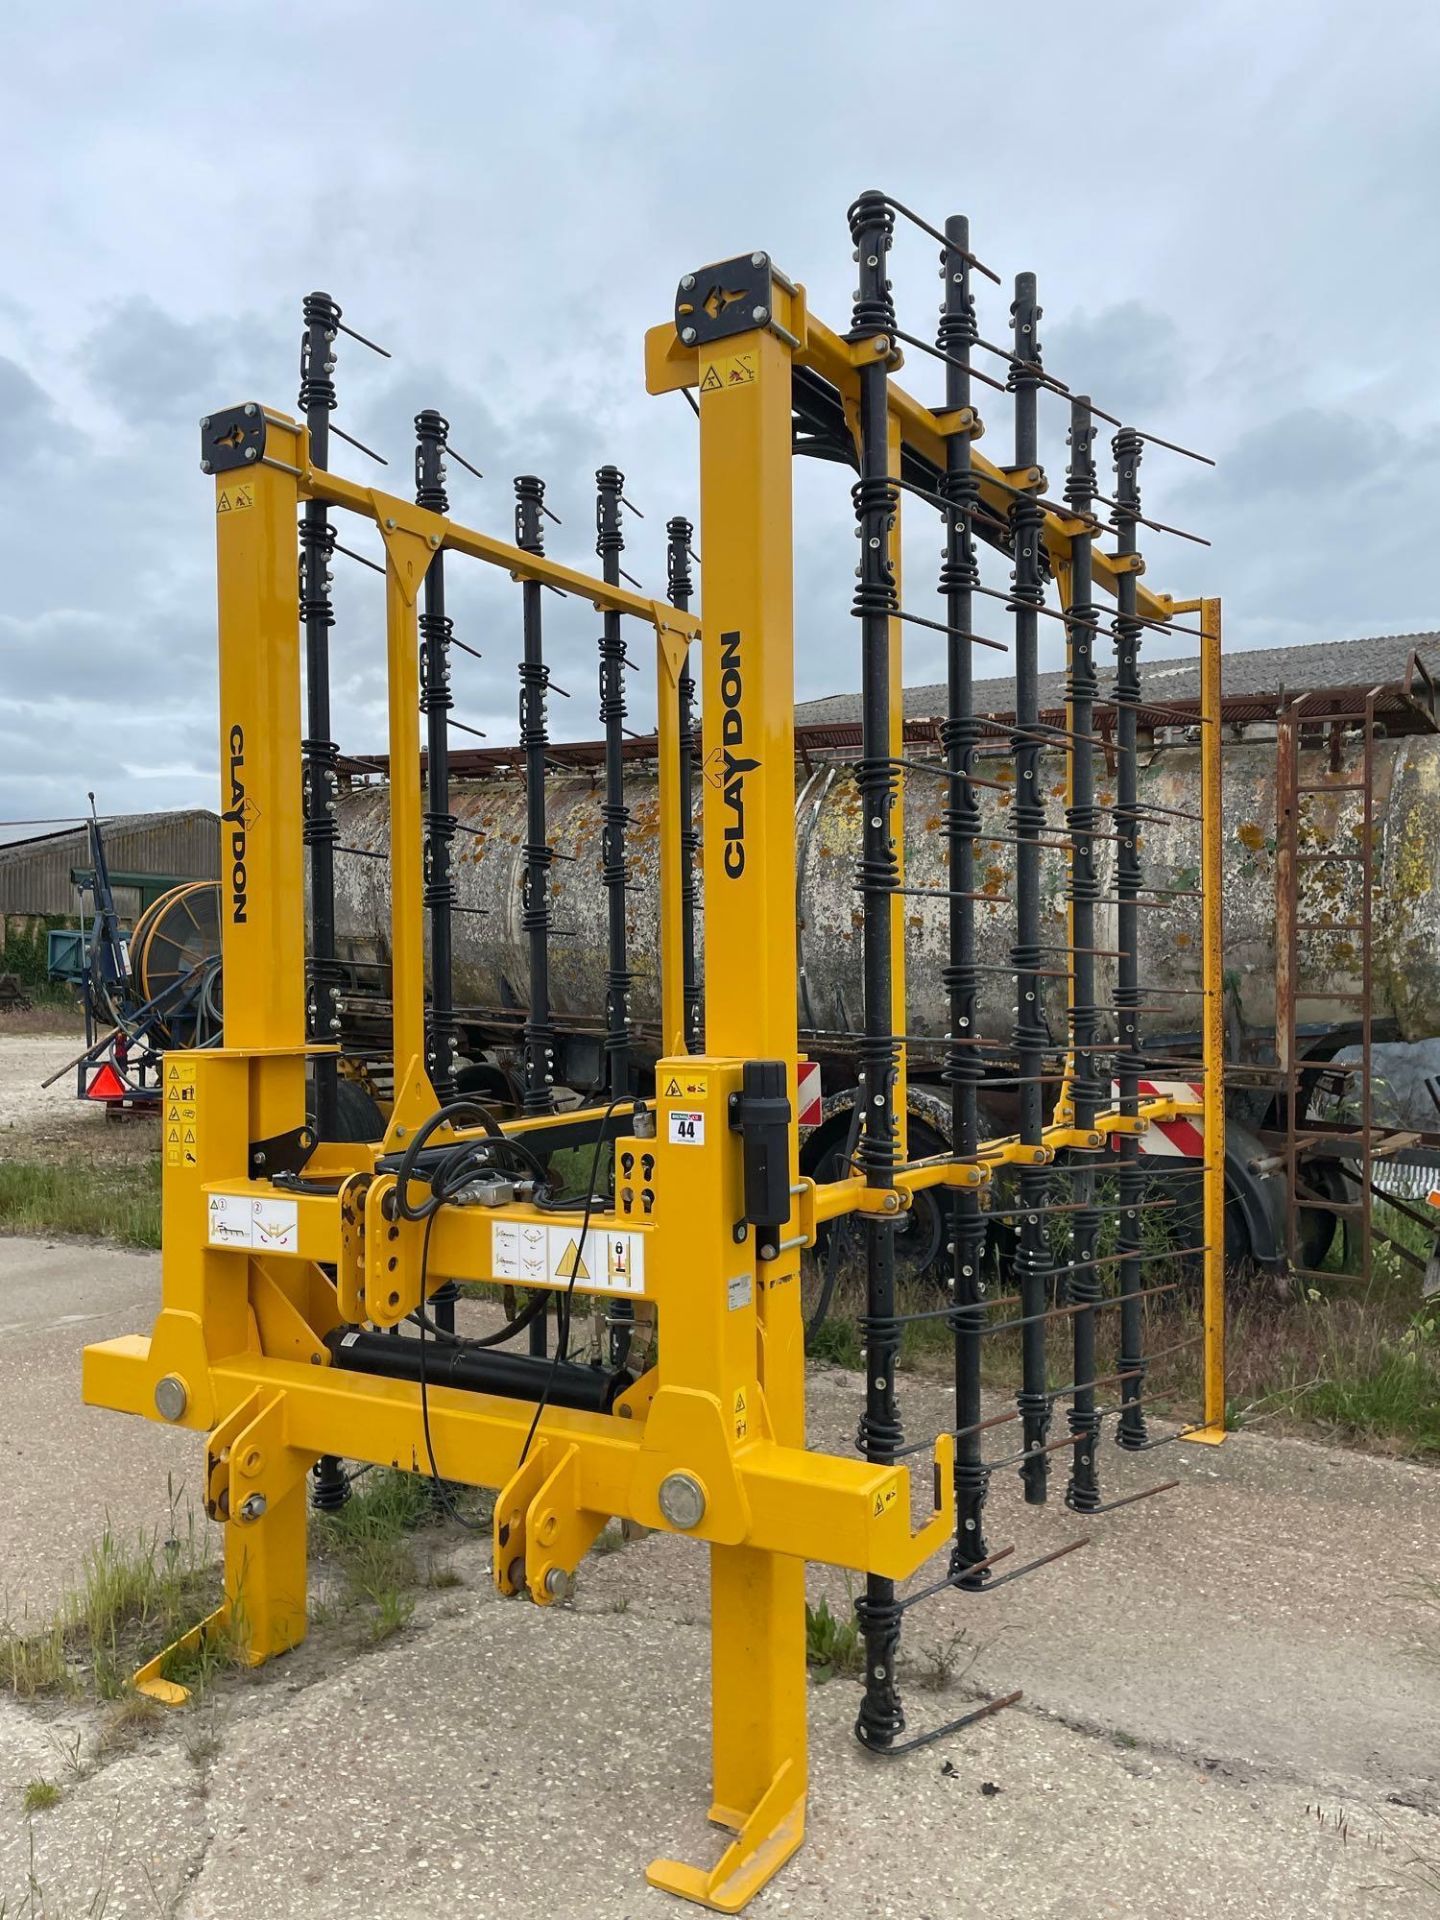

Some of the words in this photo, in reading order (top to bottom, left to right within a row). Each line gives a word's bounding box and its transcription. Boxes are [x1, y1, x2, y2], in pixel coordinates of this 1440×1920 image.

[221, 724, 248, 924] CLAYDON
[720, 630, 762, 880] CLAYDON
[678, 1121, 695, 1138] 44
